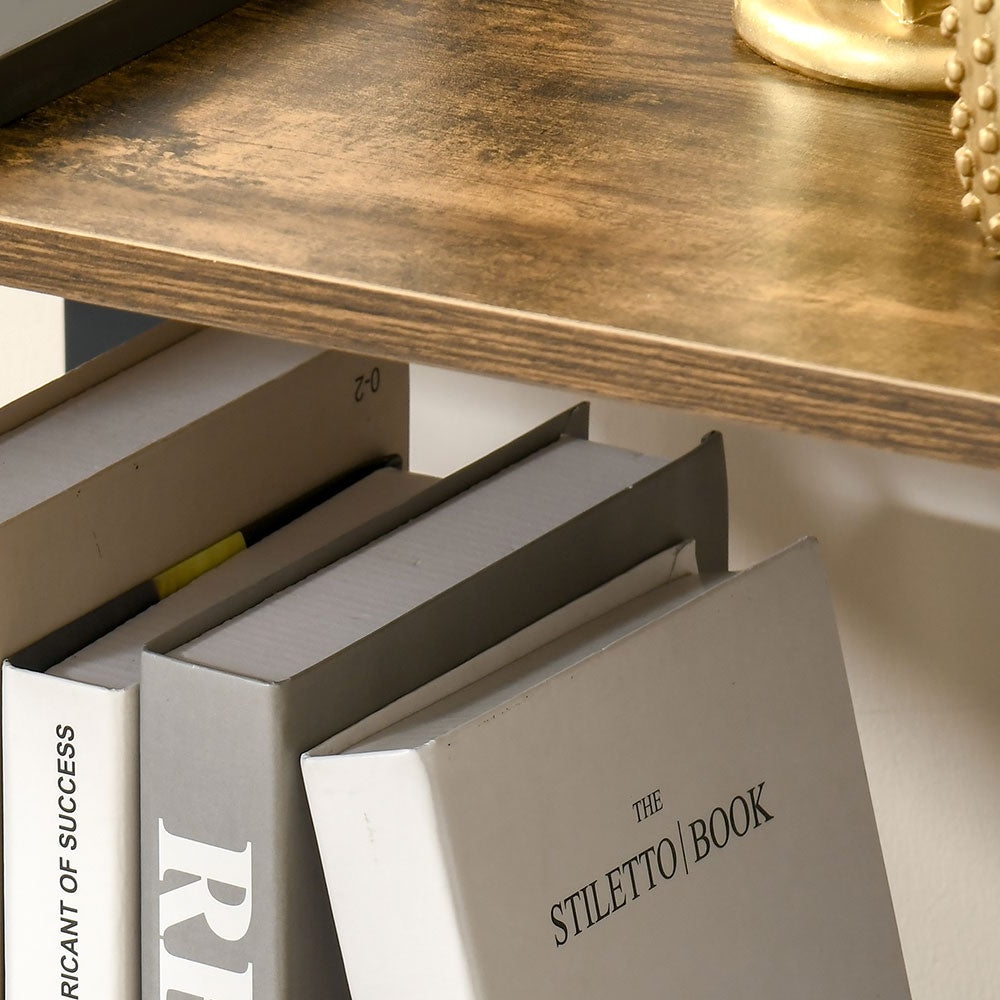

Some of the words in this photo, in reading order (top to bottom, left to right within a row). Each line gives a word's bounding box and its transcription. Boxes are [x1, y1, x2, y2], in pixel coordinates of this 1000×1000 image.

[55, 724, 78, 851] SUCCESS
[632, 789, 664, 824] THE
[59, 857, 79, 894] OF
[550, 837, 678, 948] STILETTO
[688, 781, 775, 864] BOOK
